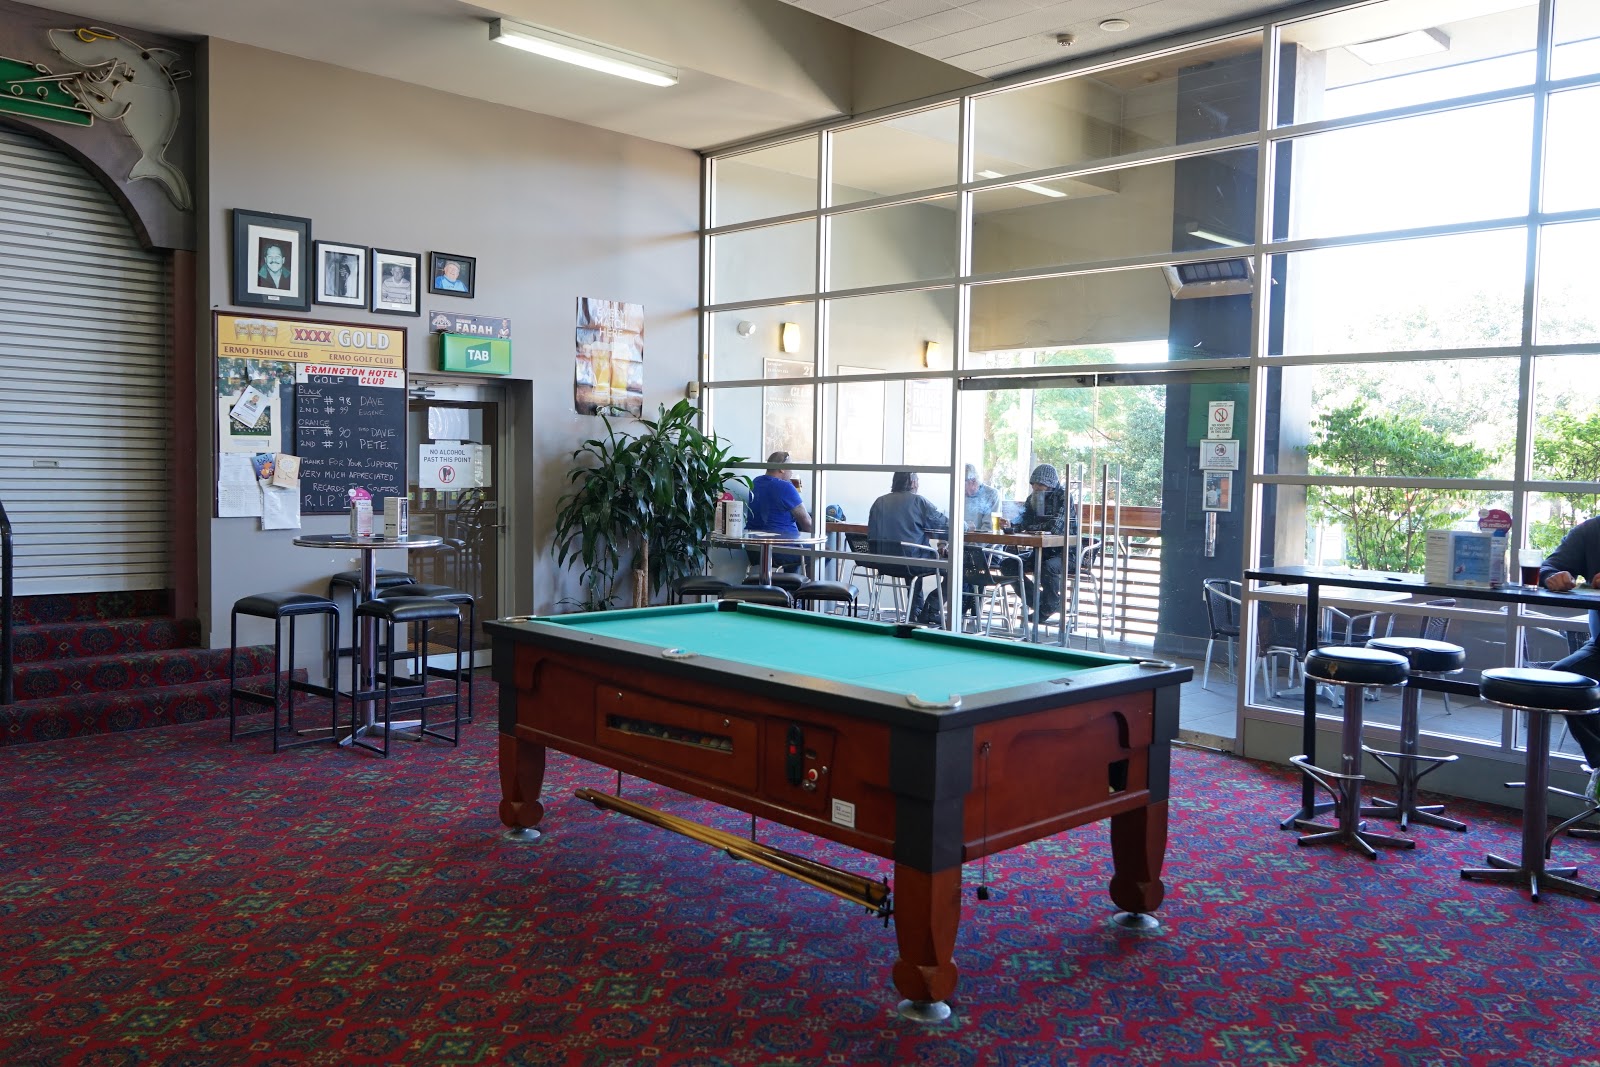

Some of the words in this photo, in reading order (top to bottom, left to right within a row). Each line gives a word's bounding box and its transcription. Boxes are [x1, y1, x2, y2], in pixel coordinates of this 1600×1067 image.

[594, 316, 627, 329] MATCH
[455, 322, 493, 335] FARAH
[599, 327, 624, 339] HERE
[294, 328, 332, 343] XXXX
[337, 329, 390, 350] GOLD
[224, 345, 250, 355] ERMO
[251, 347, 285, 357] FISHING
[287, 350, 309, 359] CLUB
[467, 349, 489, 361] TAB
[329, 353, 351, 362] ERMO
[353, 355, 374, 363] GOLF
[375, 356, 394, 364] CLUB
[304, 365, 365, 376] ERMINGTON
[368, 369, 398, 378] HOTEL
[313, 376, 345, 384] GOLF
[360, 376, 385, 385] CLUB
[298, 384, 323, 395] BLACK
[300, 397, 318, 405] 1ST
[338, 396, 352, 406] 98
[360, 395, 385, 407] DAVE
[299, 406, 319, 414] 2ND
[298, 418, 330, 427] ORANGE
[300, 428, 318, 436] 1ST
[299, 440, 316, 448] 2ND
[300, 456, 324, 465] THANKS
[328, 457, 345, 467] FOR
[347, 457, 362, 467] YOUR
[300, 470, 321, 478] VERY
[324, 471, 346, 479] MUCH
[348, 471, 394, 481] APPRECIATED
[312, 482, 345, 492] REGARDS
